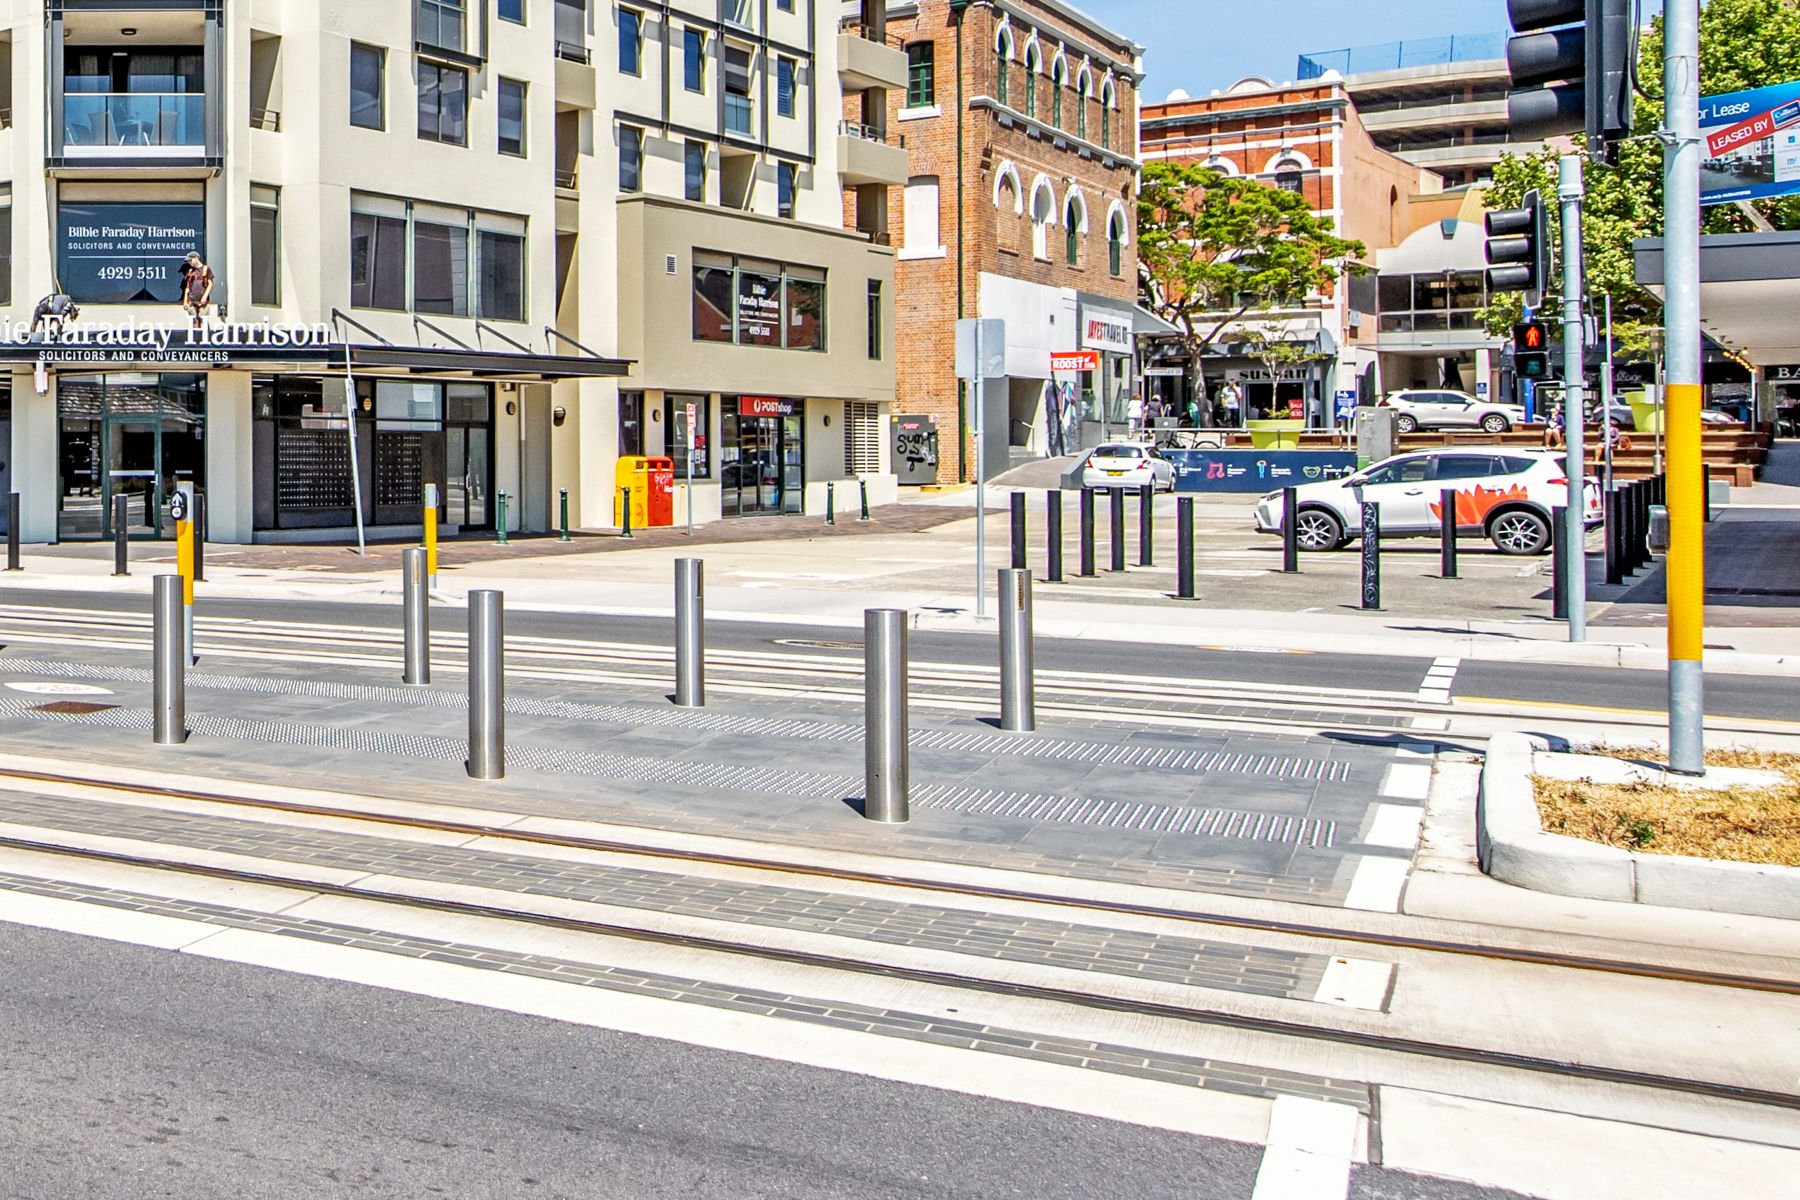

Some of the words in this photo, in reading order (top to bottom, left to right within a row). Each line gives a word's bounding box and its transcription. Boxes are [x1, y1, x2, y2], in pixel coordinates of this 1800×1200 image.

[1713, 101, 1750, 118] Lease
[1711, 125, 1753, 151] LEASED
[1754, 118, 1769, 134] BY
[68, 226, 100, 238] Bilbie
[102, 226, 145, 240] Faraday
[148, 226, 195, 238] Harrison
[68, 242, 113, 250] SOLICITORS
[116, 242, 132, 250] AND
[136, 242, 196, 250] CONVEYANCERS
[97, 266, 133, 280] 4929
[137, 266, 167, 280] 5511
[40, 313, 174, 351] Faraday
[184, 313, 330, 345] Harrison
[38, 350, 106, 361] SOLICITORS
[111, 350, 135, 361] AND
[141, 350, 229, 361] CONVEYANCERS
[1052, 356, 1084, 369] ROOST
